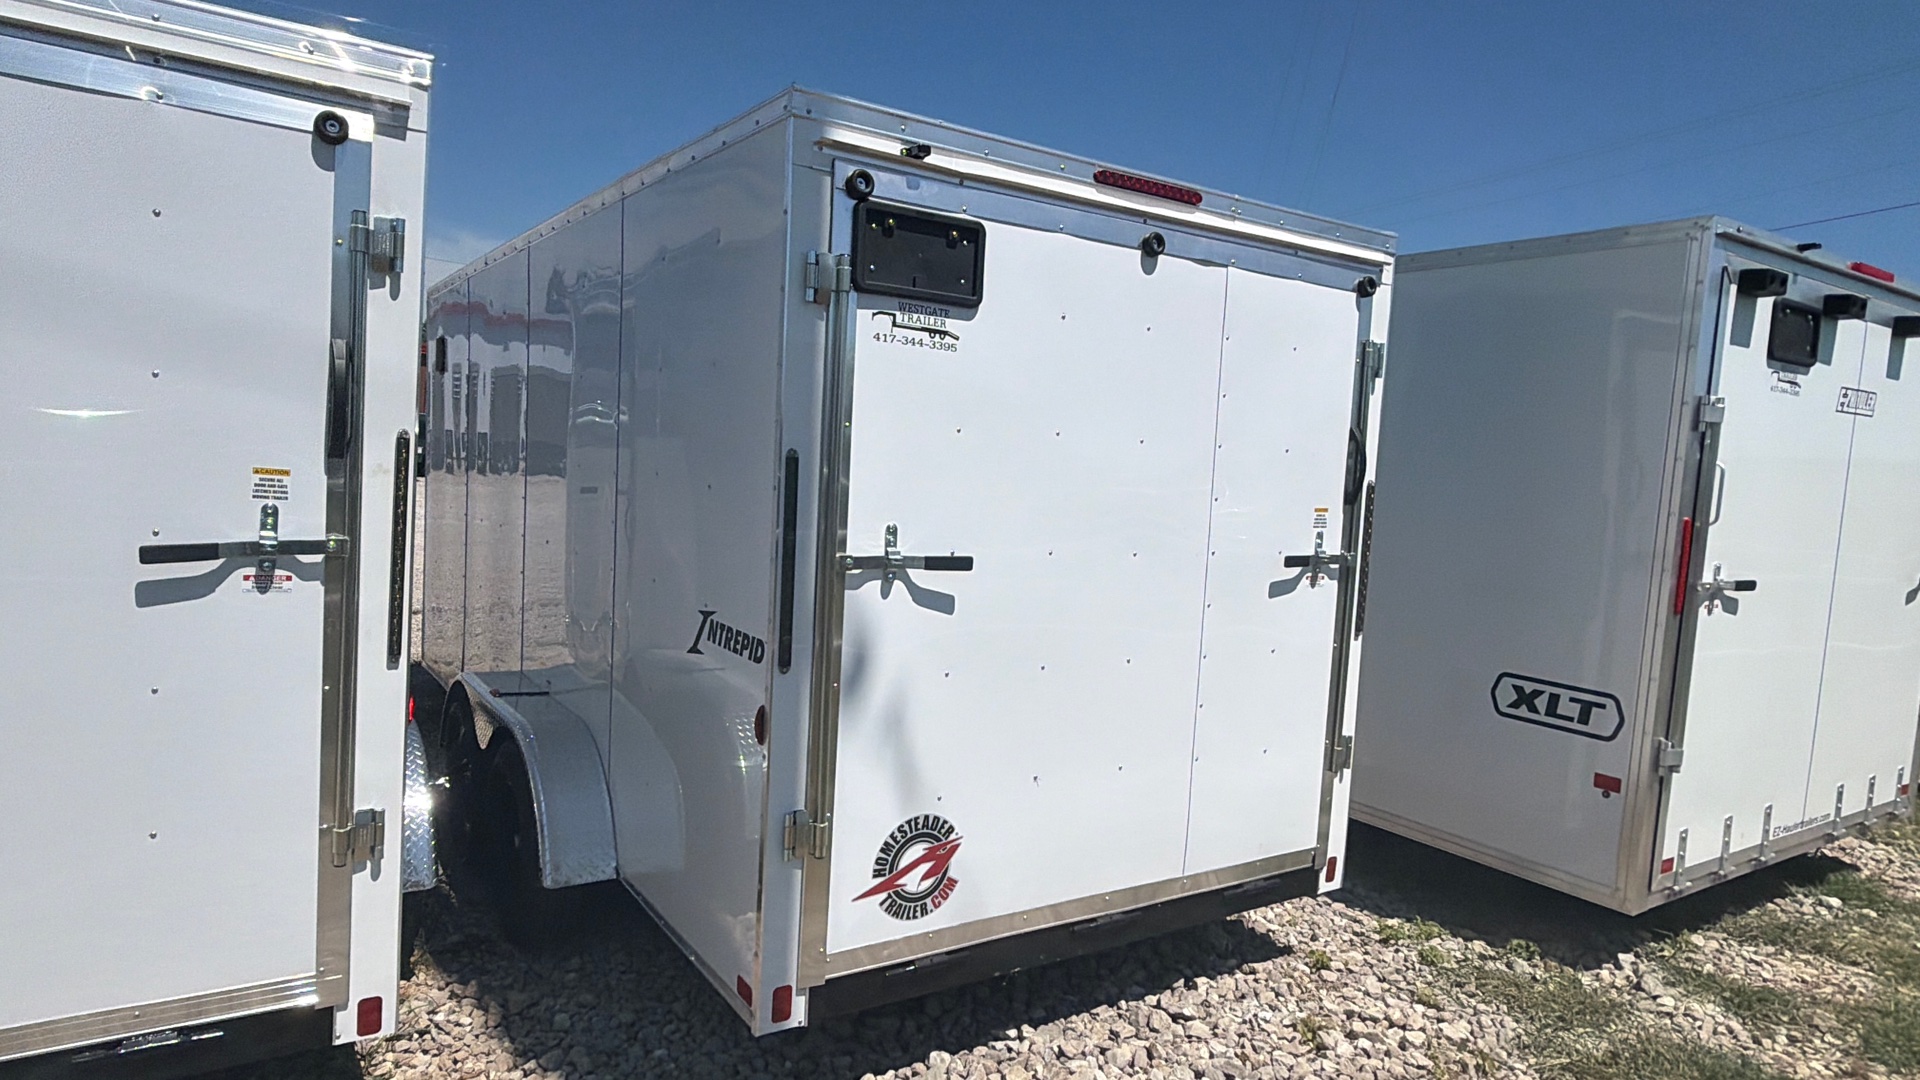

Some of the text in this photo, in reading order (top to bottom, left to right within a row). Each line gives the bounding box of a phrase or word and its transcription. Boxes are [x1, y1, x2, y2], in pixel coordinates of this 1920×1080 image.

[898, 301, 950, 319] WESTGATE
[900, 312, 947, 329] TRAILER
[872, 332, 958, 353] 417-344-3395
[259, 468, 290, 476] CAUTION
[686, 609, 766, 665] INTREPID
[1505, 683, 1607, 727] XLT
[871, 814, 956, 879] HOMESTEADER
